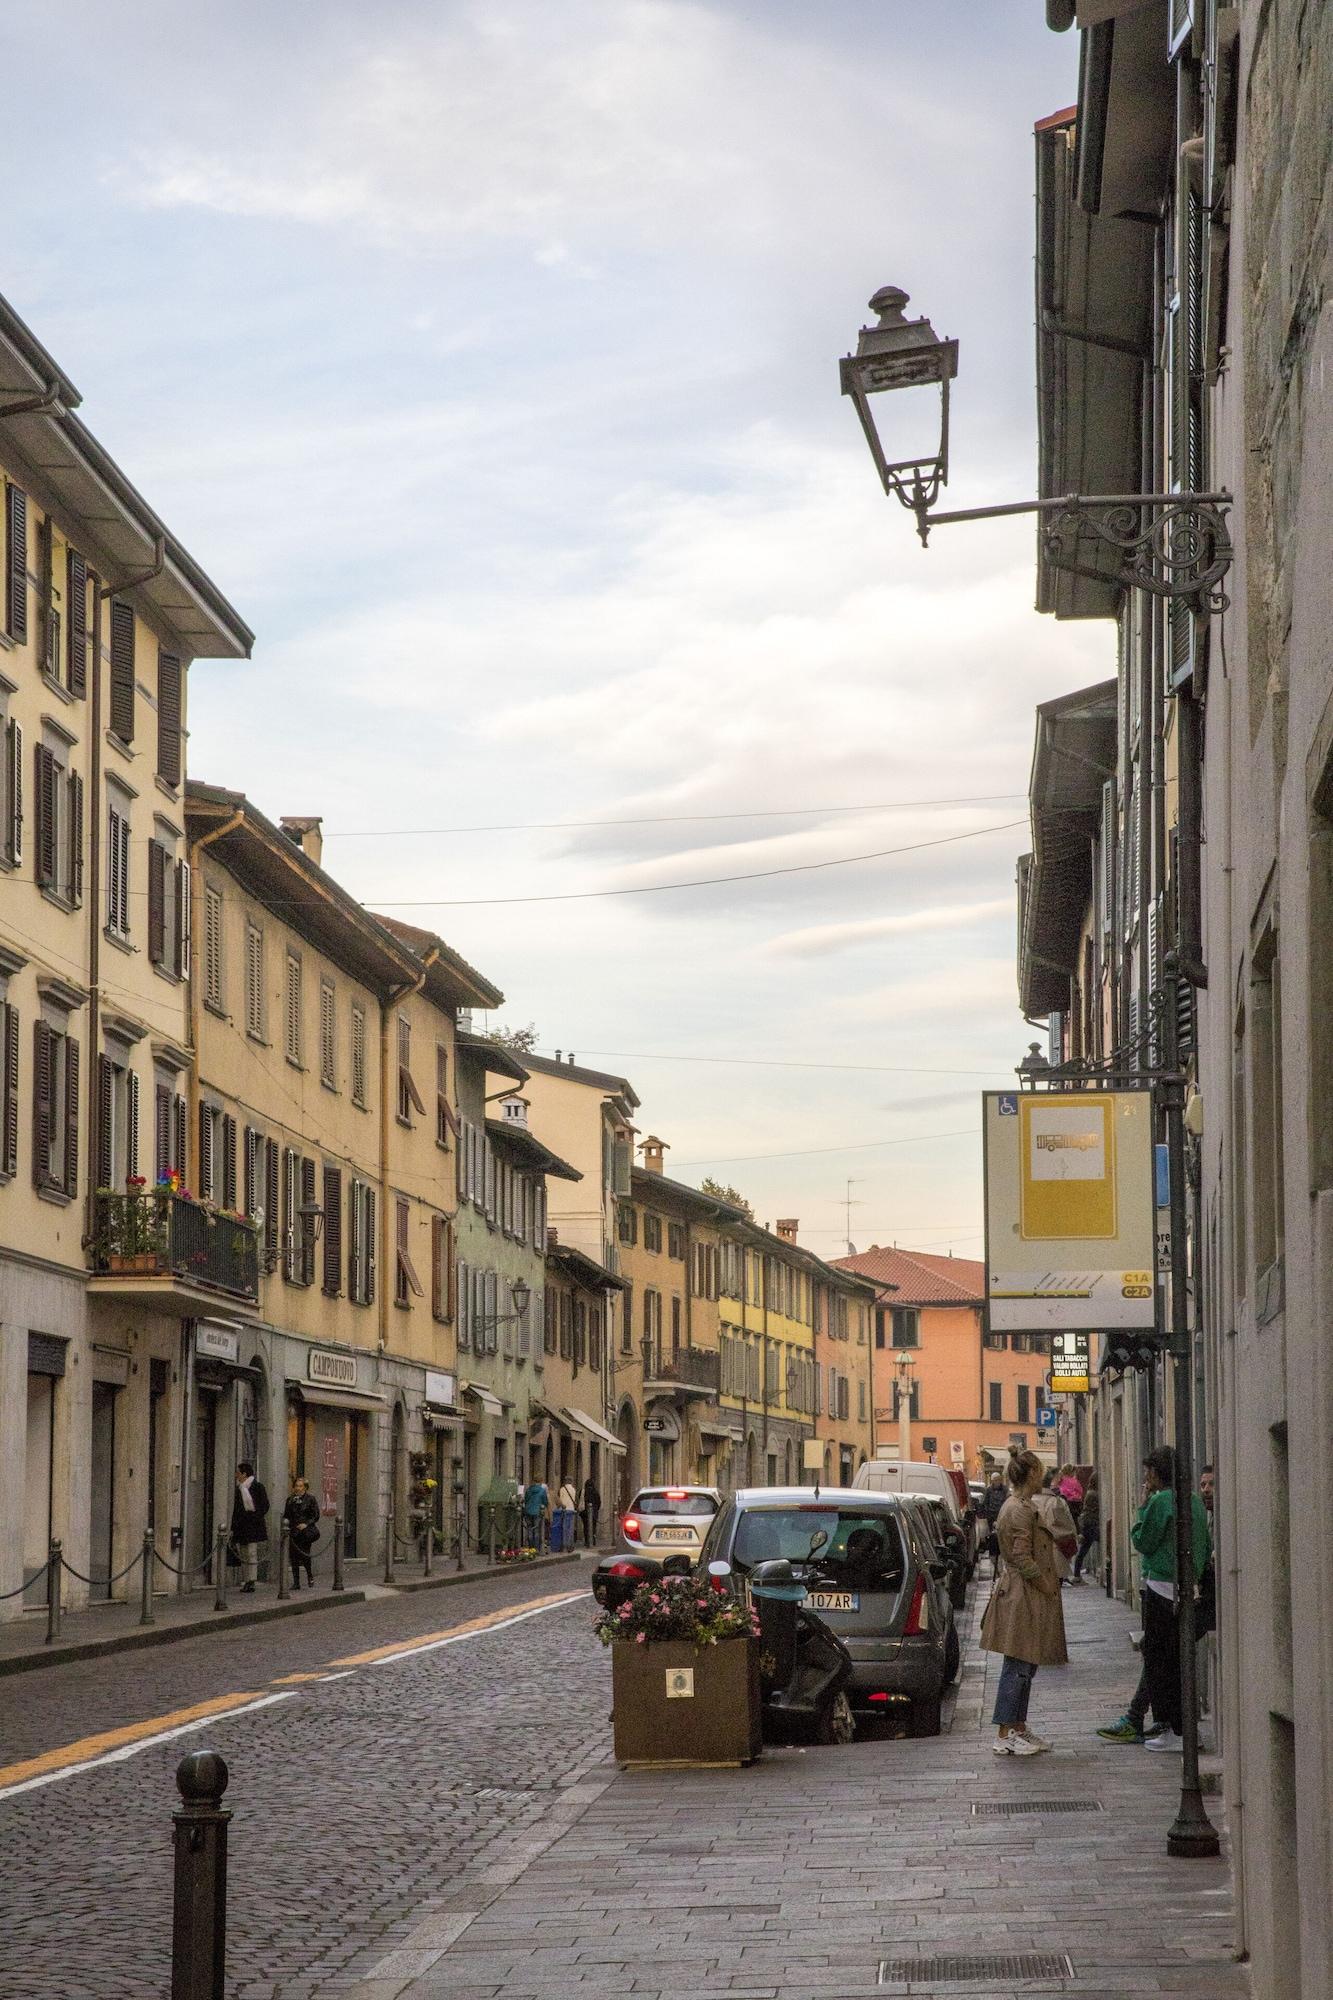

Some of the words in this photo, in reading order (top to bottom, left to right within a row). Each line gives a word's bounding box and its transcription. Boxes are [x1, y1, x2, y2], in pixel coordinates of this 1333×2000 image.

[1124, 1274, 1149, 1282] C1A
[1124, 1287, 1149, 1296] C2A
[1053, 1362, 1070, 1370] VALORI
[1070, 1362, 1088, 1370] BOLLATI
[1040, 1411, 1052, 1425] P
[811, 1594, 851, 1608] 107AR
